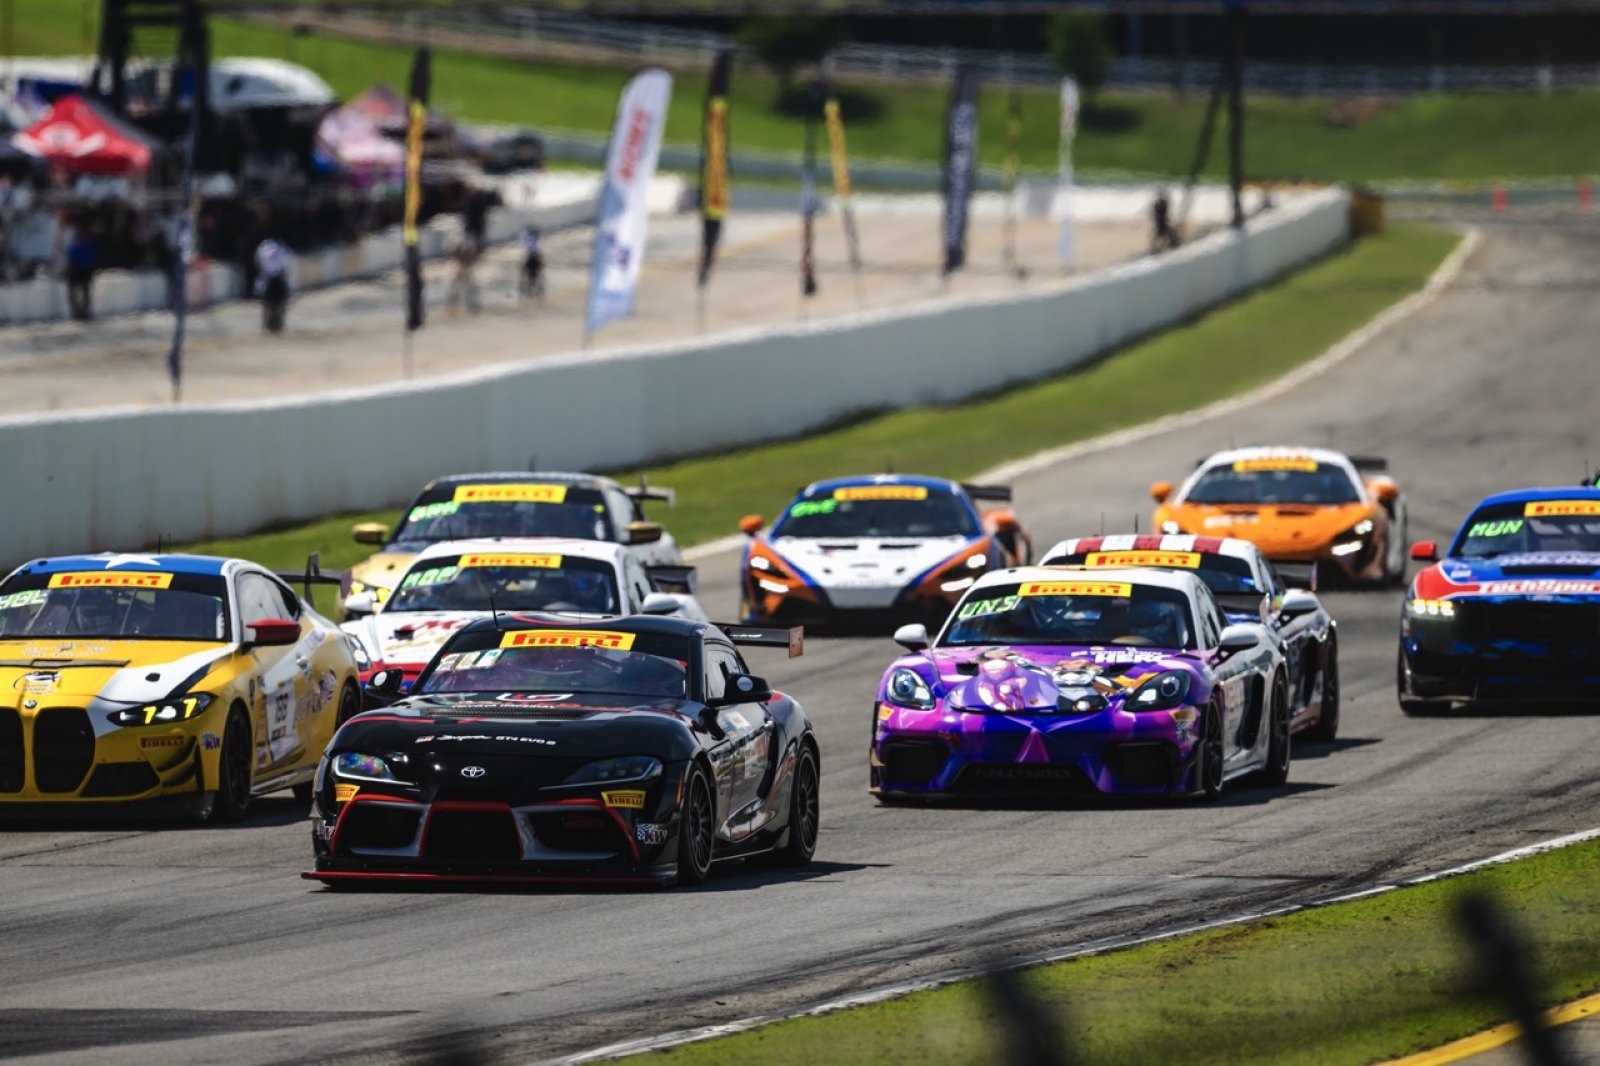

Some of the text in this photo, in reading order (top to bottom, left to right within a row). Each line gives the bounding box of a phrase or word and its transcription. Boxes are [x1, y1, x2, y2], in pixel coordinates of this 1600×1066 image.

[469, 556, 551, 566] PIRELLI
[1096, 555, 1190, 566] PIRELLI
[60, 575, 161, 586] PIRELLI
[1029, 584, 1121, 594] PIRELLI
[512, 633, 624, 647] PIRELLI
[141, 734, 185, 749] PIRELLI
[607, 793, 644, 805] PIRELLI
